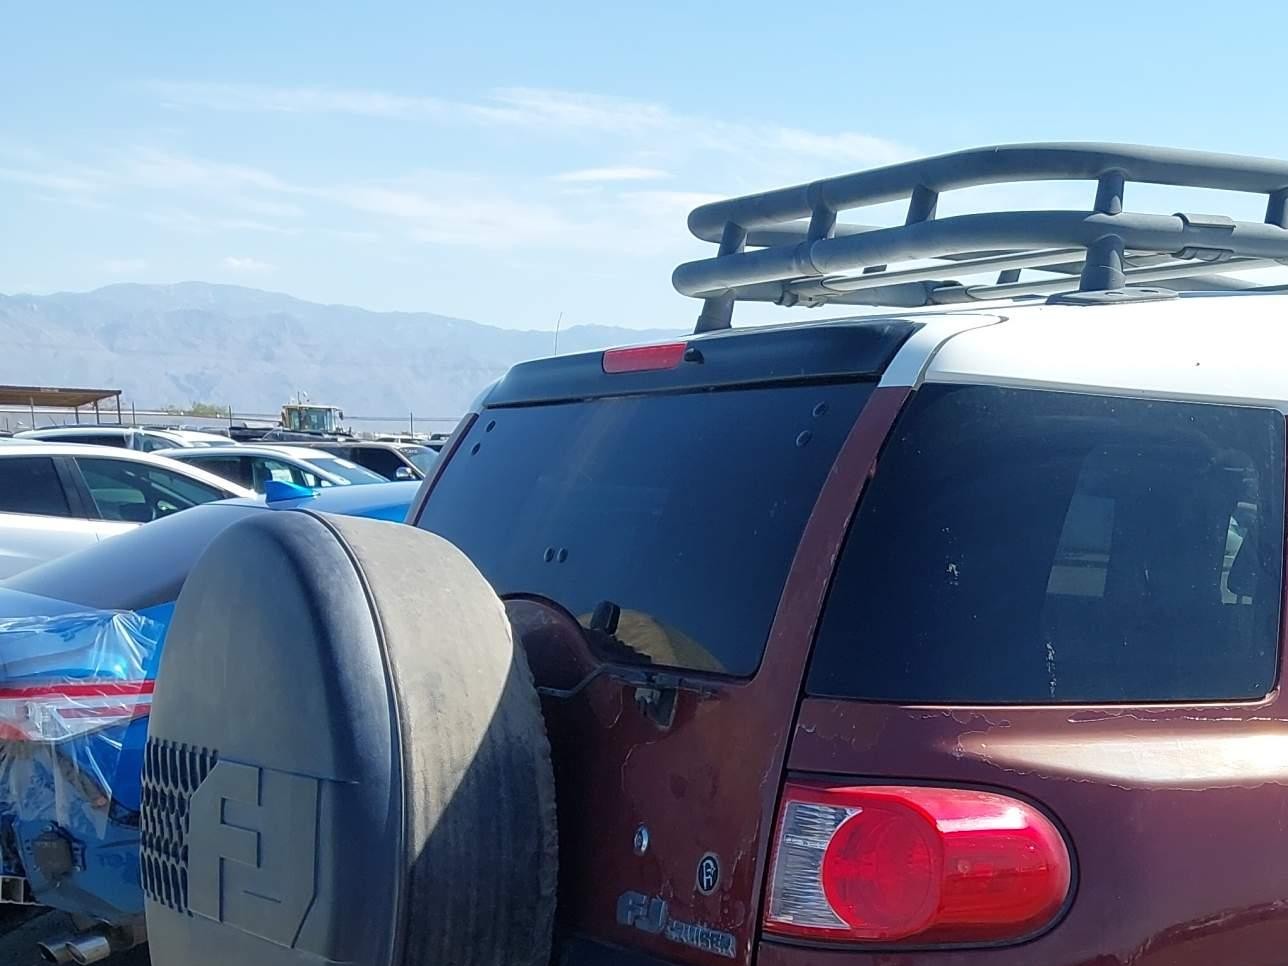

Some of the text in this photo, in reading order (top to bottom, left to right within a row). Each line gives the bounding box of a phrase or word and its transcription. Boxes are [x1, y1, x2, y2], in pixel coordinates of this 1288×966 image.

[188, 759, 320, 947] FJ
[617, 891, 737, 959] FJ CRUISER
